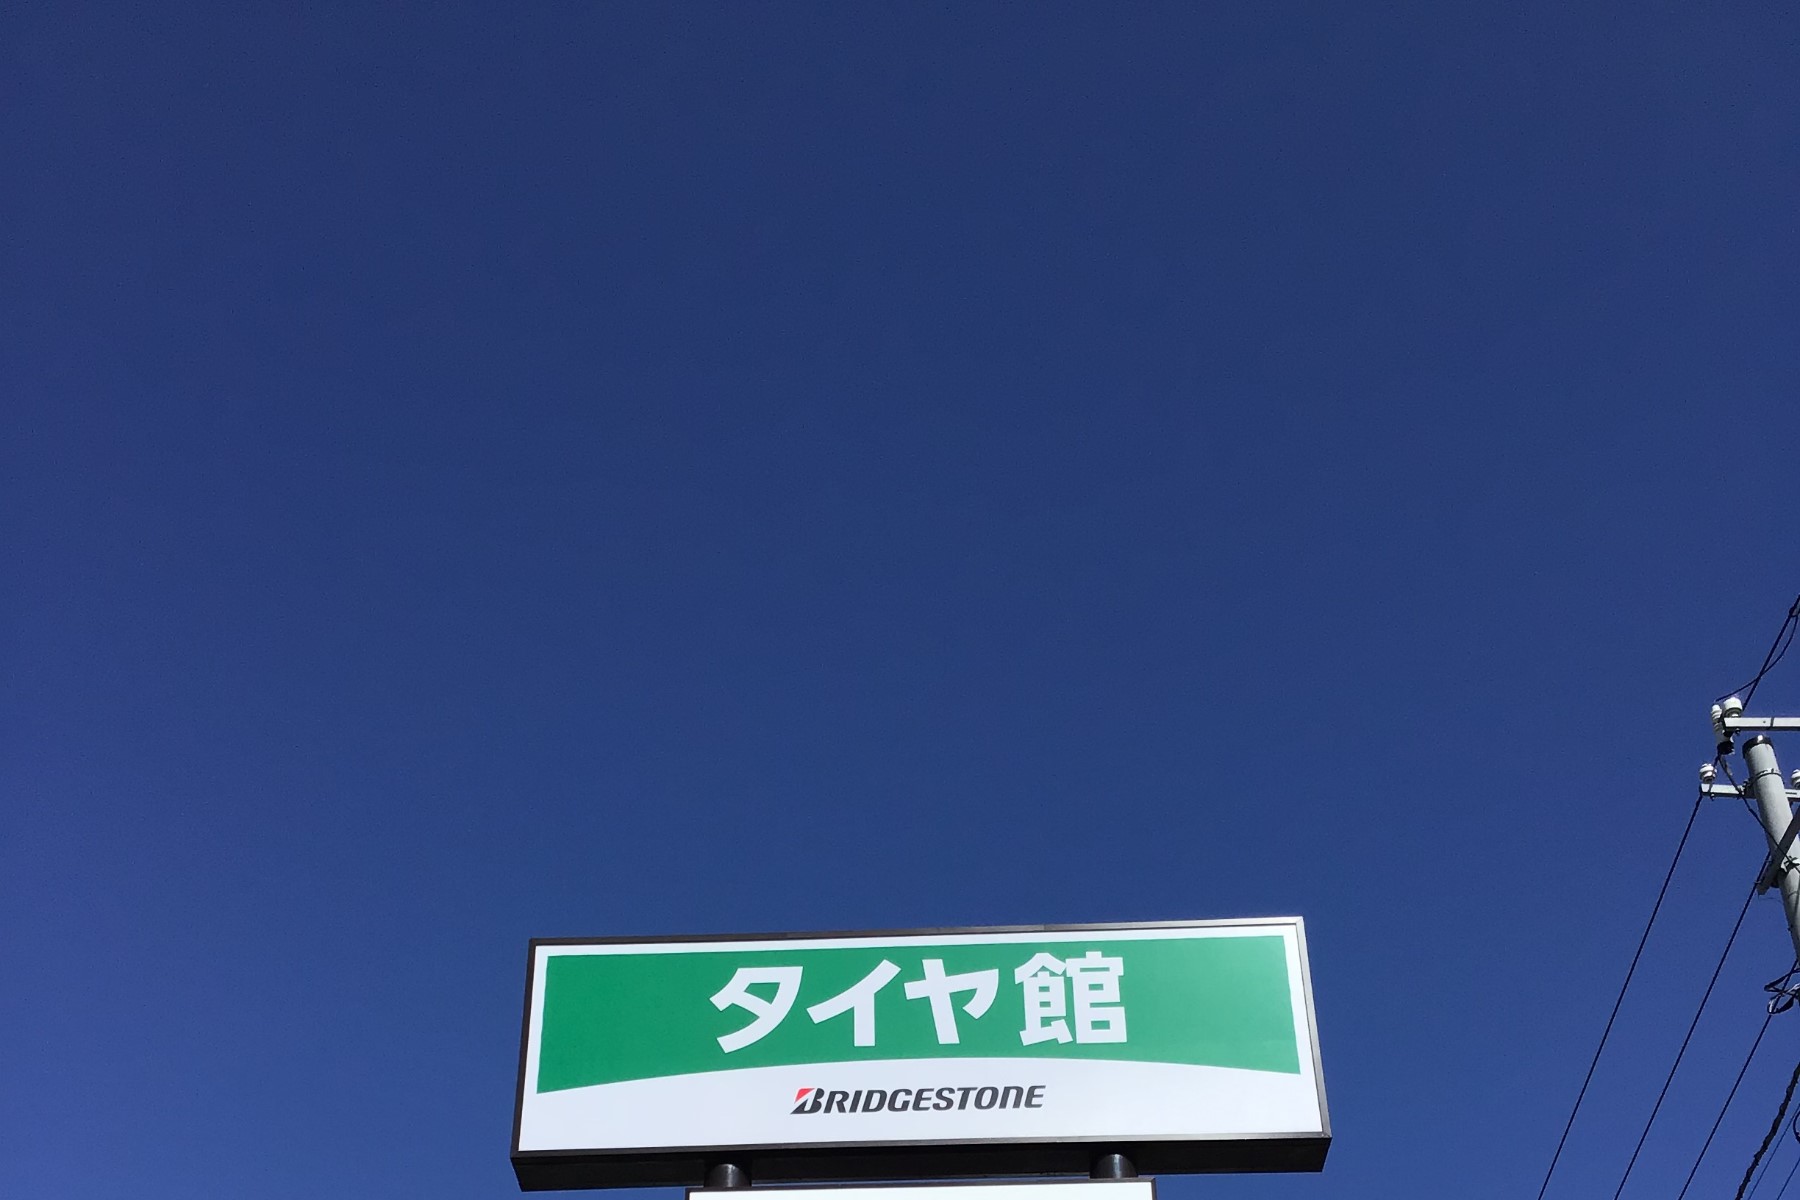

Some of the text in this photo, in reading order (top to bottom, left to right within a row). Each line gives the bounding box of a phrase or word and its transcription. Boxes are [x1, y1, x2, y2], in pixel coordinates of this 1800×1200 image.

[709, 950, 1129, 1054] タイヤ館
[790, 1084, 1047, 1115] BRIDGESTONE
